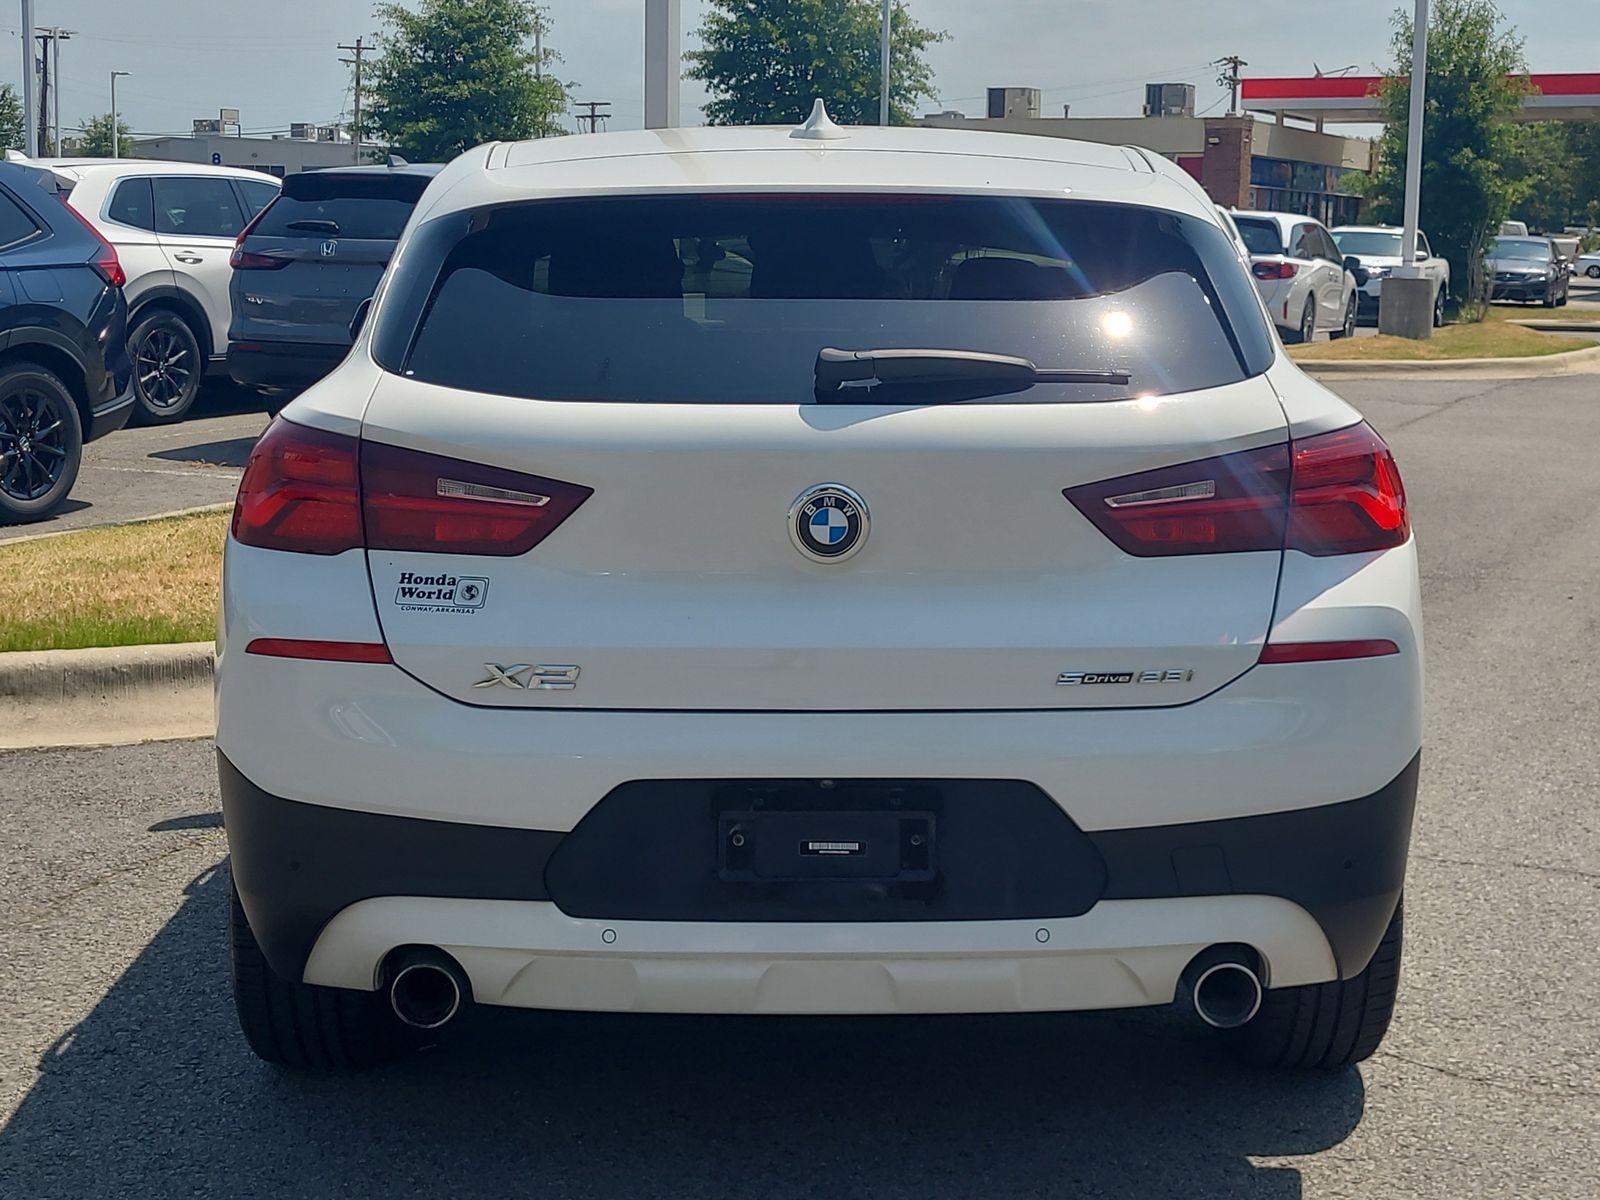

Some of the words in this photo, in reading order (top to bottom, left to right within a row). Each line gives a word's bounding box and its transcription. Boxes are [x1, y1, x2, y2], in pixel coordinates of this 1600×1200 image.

[212, 152, 221, 165] 8
[804, 497, 856, 517] BMW
[399, 572, 457, 586] Honda
[400, 586, 454, 600] World
[400, 605, 434, 613] CONWAY,
[435, 607, 475, 615] ARKANSAS
[472, 663, 581, 690] X2
